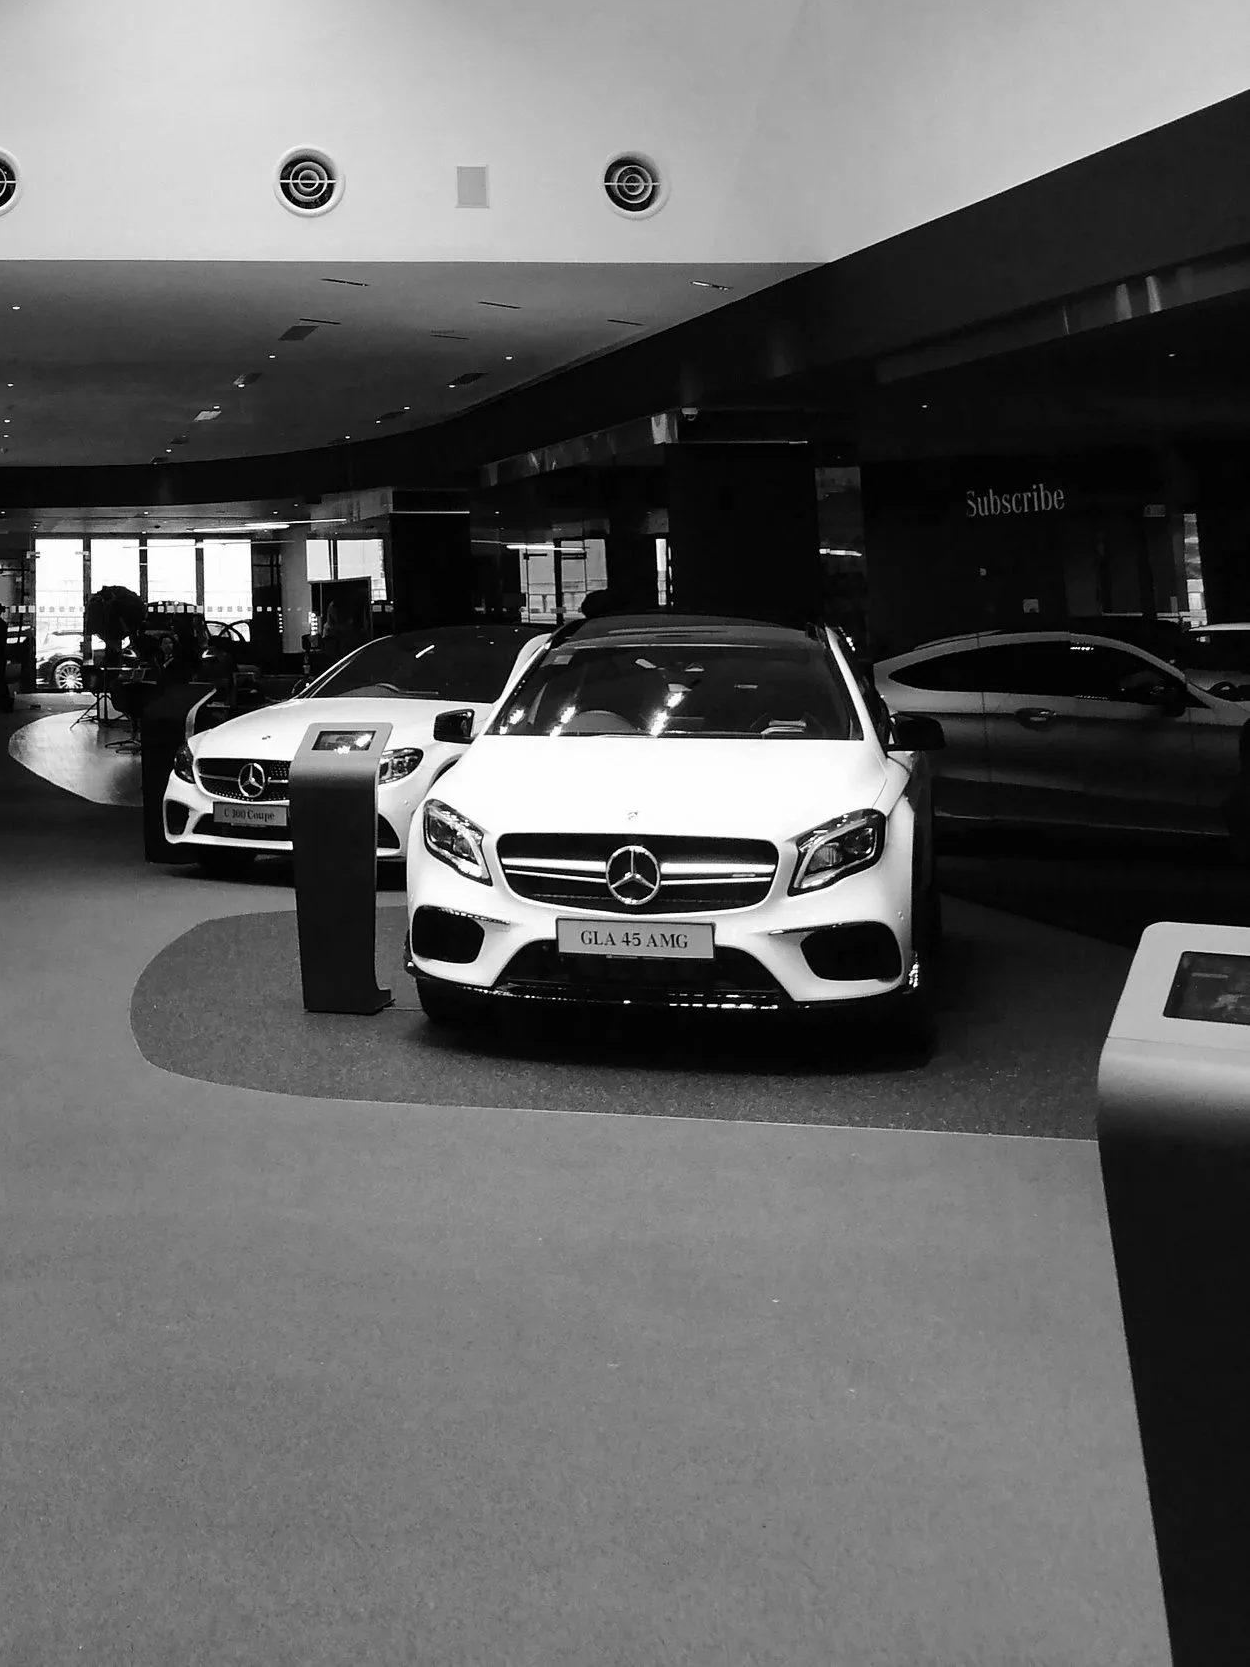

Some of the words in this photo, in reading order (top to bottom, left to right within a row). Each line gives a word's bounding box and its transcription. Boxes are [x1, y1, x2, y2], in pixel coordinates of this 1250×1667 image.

[966, 483, 1065, 517] Subscribe
[580, 930, 616, 946] GLA
[621, 932, 642, 947] 45
[646, 934, 688, 949] AMG
